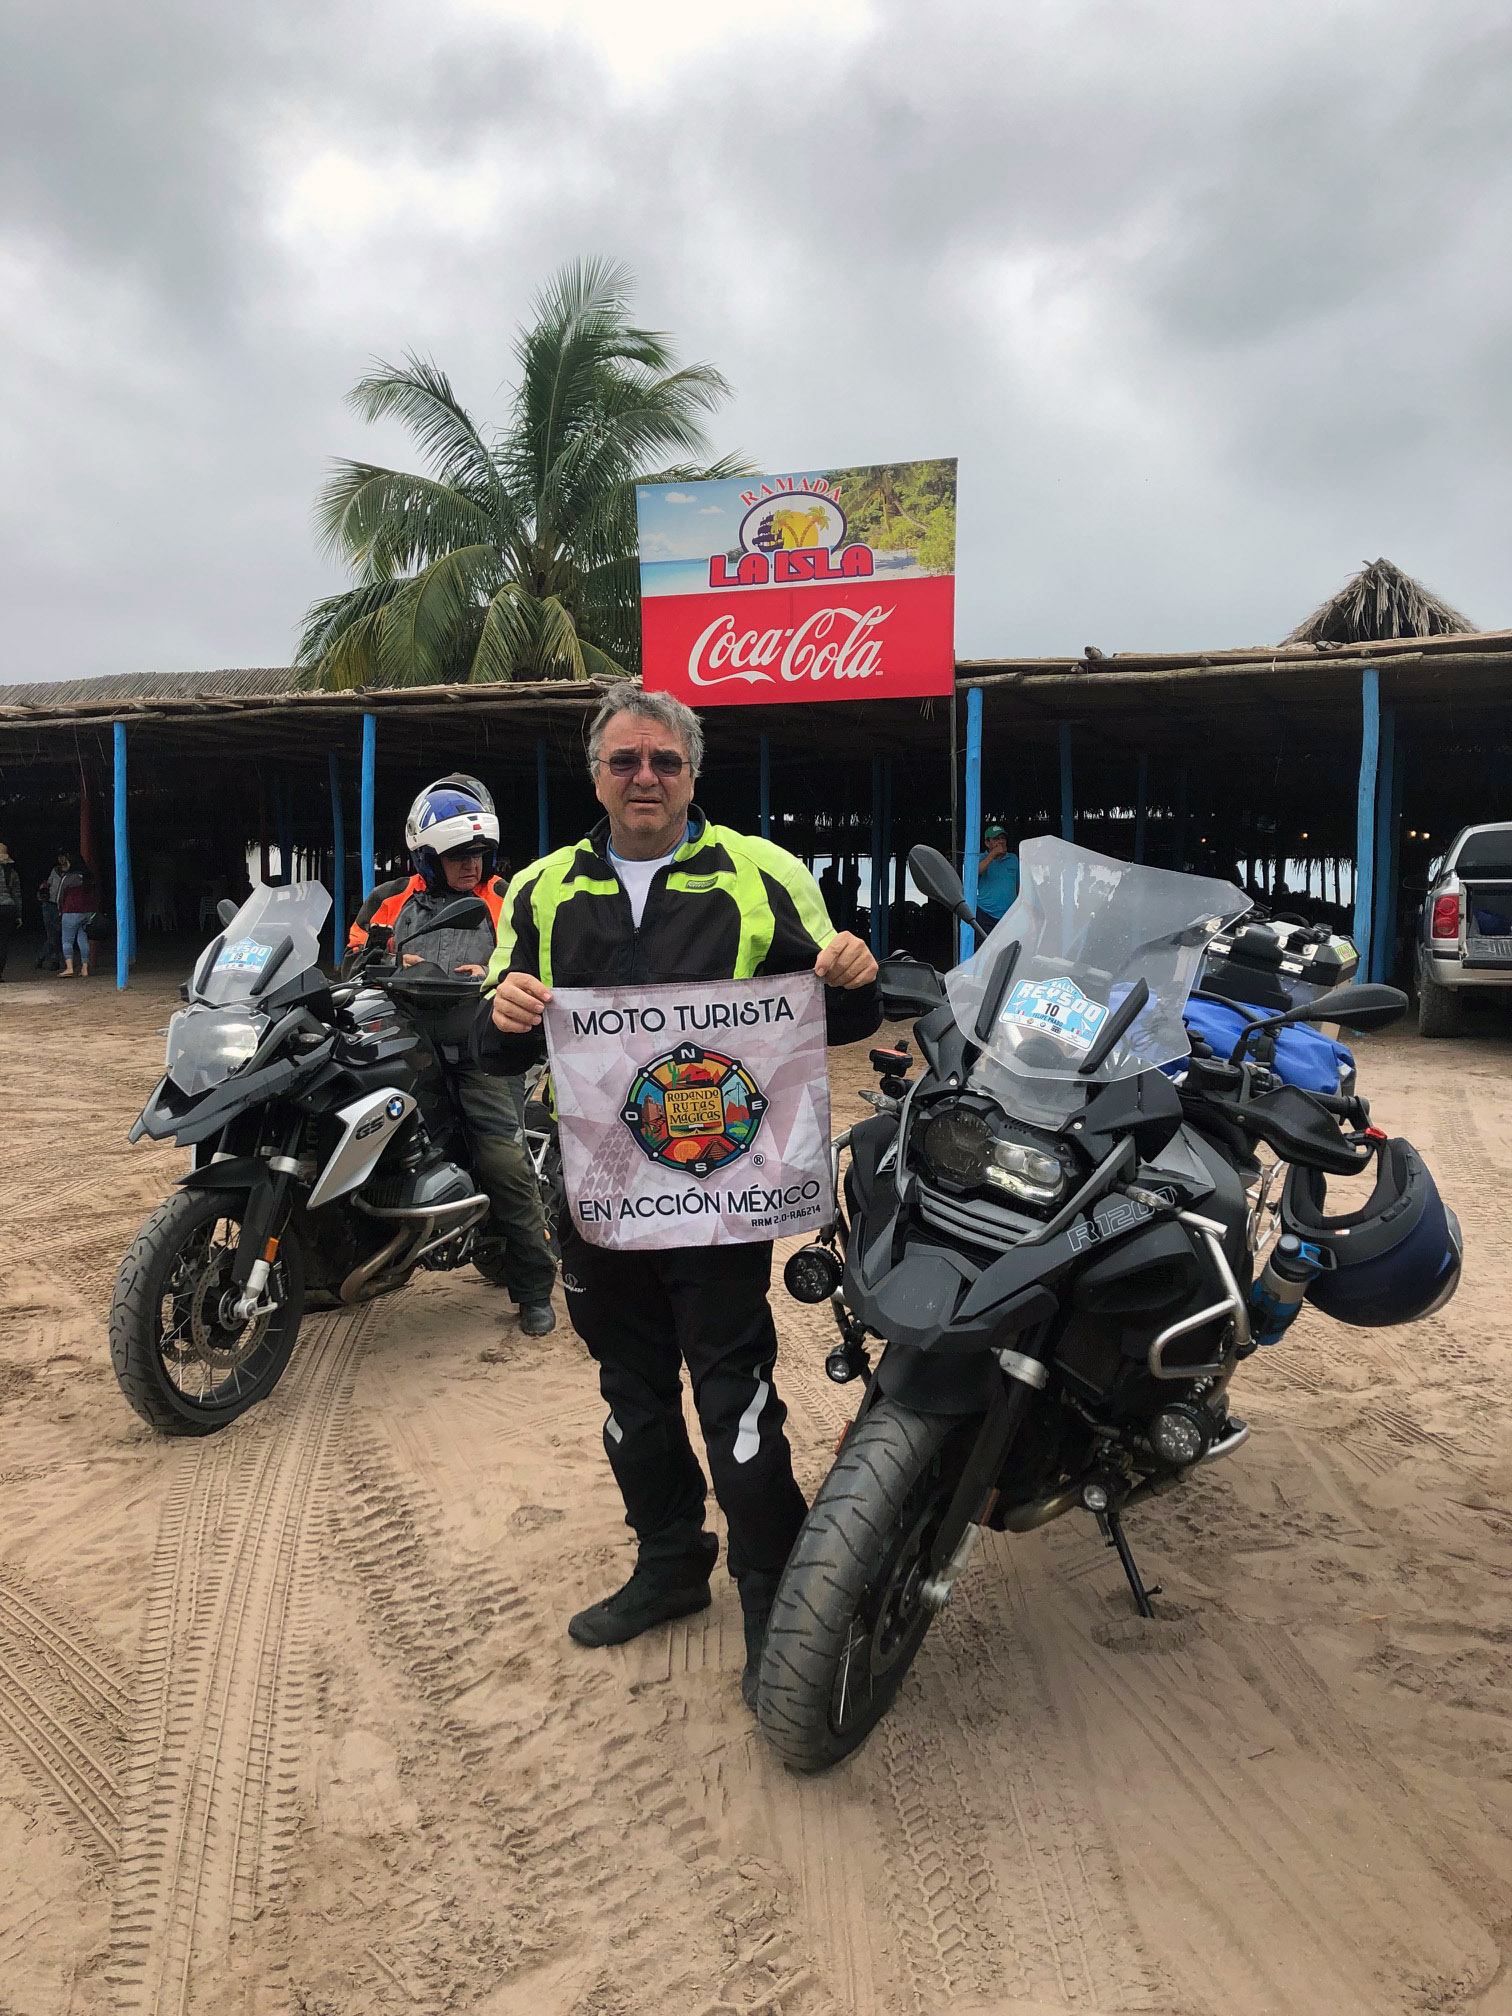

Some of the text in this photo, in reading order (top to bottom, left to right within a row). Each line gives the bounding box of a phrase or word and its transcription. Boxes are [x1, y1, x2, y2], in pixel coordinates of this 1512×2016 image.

[740, 477, 842, 506] RAMADA
[709, 544, 874, 588] LA ISLA
[688, 603, 898, 686] Coca-Cola
[1051, 981, 1076, 993] RALLY
[572, 996, 795, 1036] MOTO TURISTA
[1016, 982, 1103, 1023] REY500
[1044, 1002, 1060, 1018] 10
[681, 1048, 696, 1060] N
[751, 1100, 763, 1111] E
[356, 1114, 385, 1141] GS
[694, 1162, 708, 1173] S
[578, 1180, 821, 1222] EN ACCIÓN MÉXICO
[751, 1217, 773, 1227] RRM
